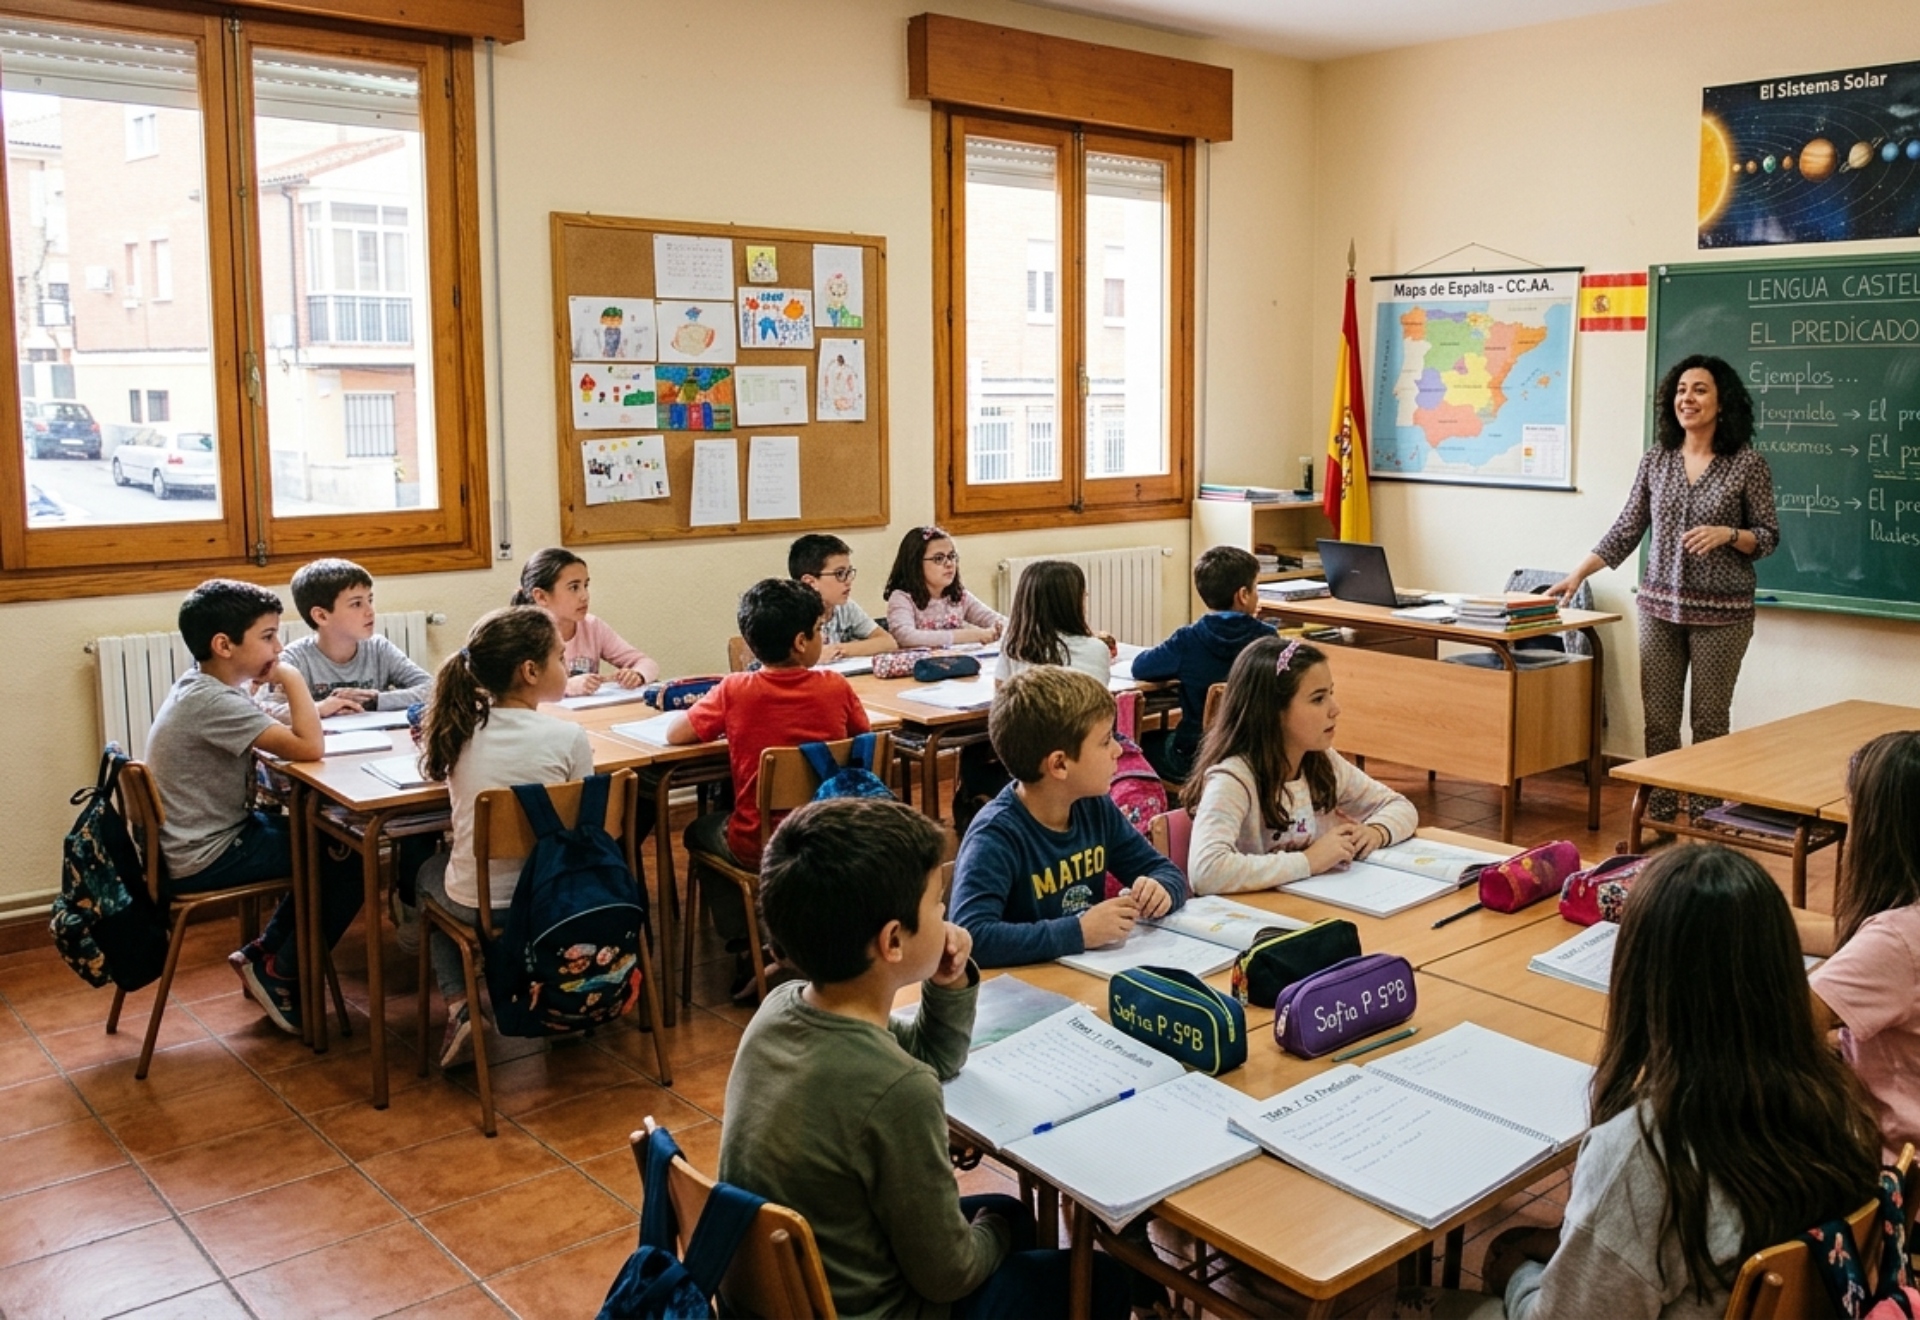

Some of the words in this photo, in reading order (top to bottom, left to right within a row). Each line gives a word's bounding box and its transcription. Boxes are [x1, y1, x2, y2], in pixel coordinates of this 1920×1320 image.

[1760, 83, 1774, 100] El
[1777, 79, 1840, 98] Sistema
[1843, 71, 1888, 91] Solar
[1393, 283, 1427, 299] Maps
[1430, 282, 1445, 296] de
[1748, 276, 1829, 301] LENGUA
[1751, 322, 1776, 344] EL
[1868, 398, 1887, 422] El
[1868, 434, 1889, 463] El
[1868, 488, 1885, 511] El
[1031, 845, 1105, 900] MATEO
[1113, 994, 1153, 1032] Sofia
[1314, 1000, 1358, 1033] Sofia
[1361, 990, 1372, 1014] P
